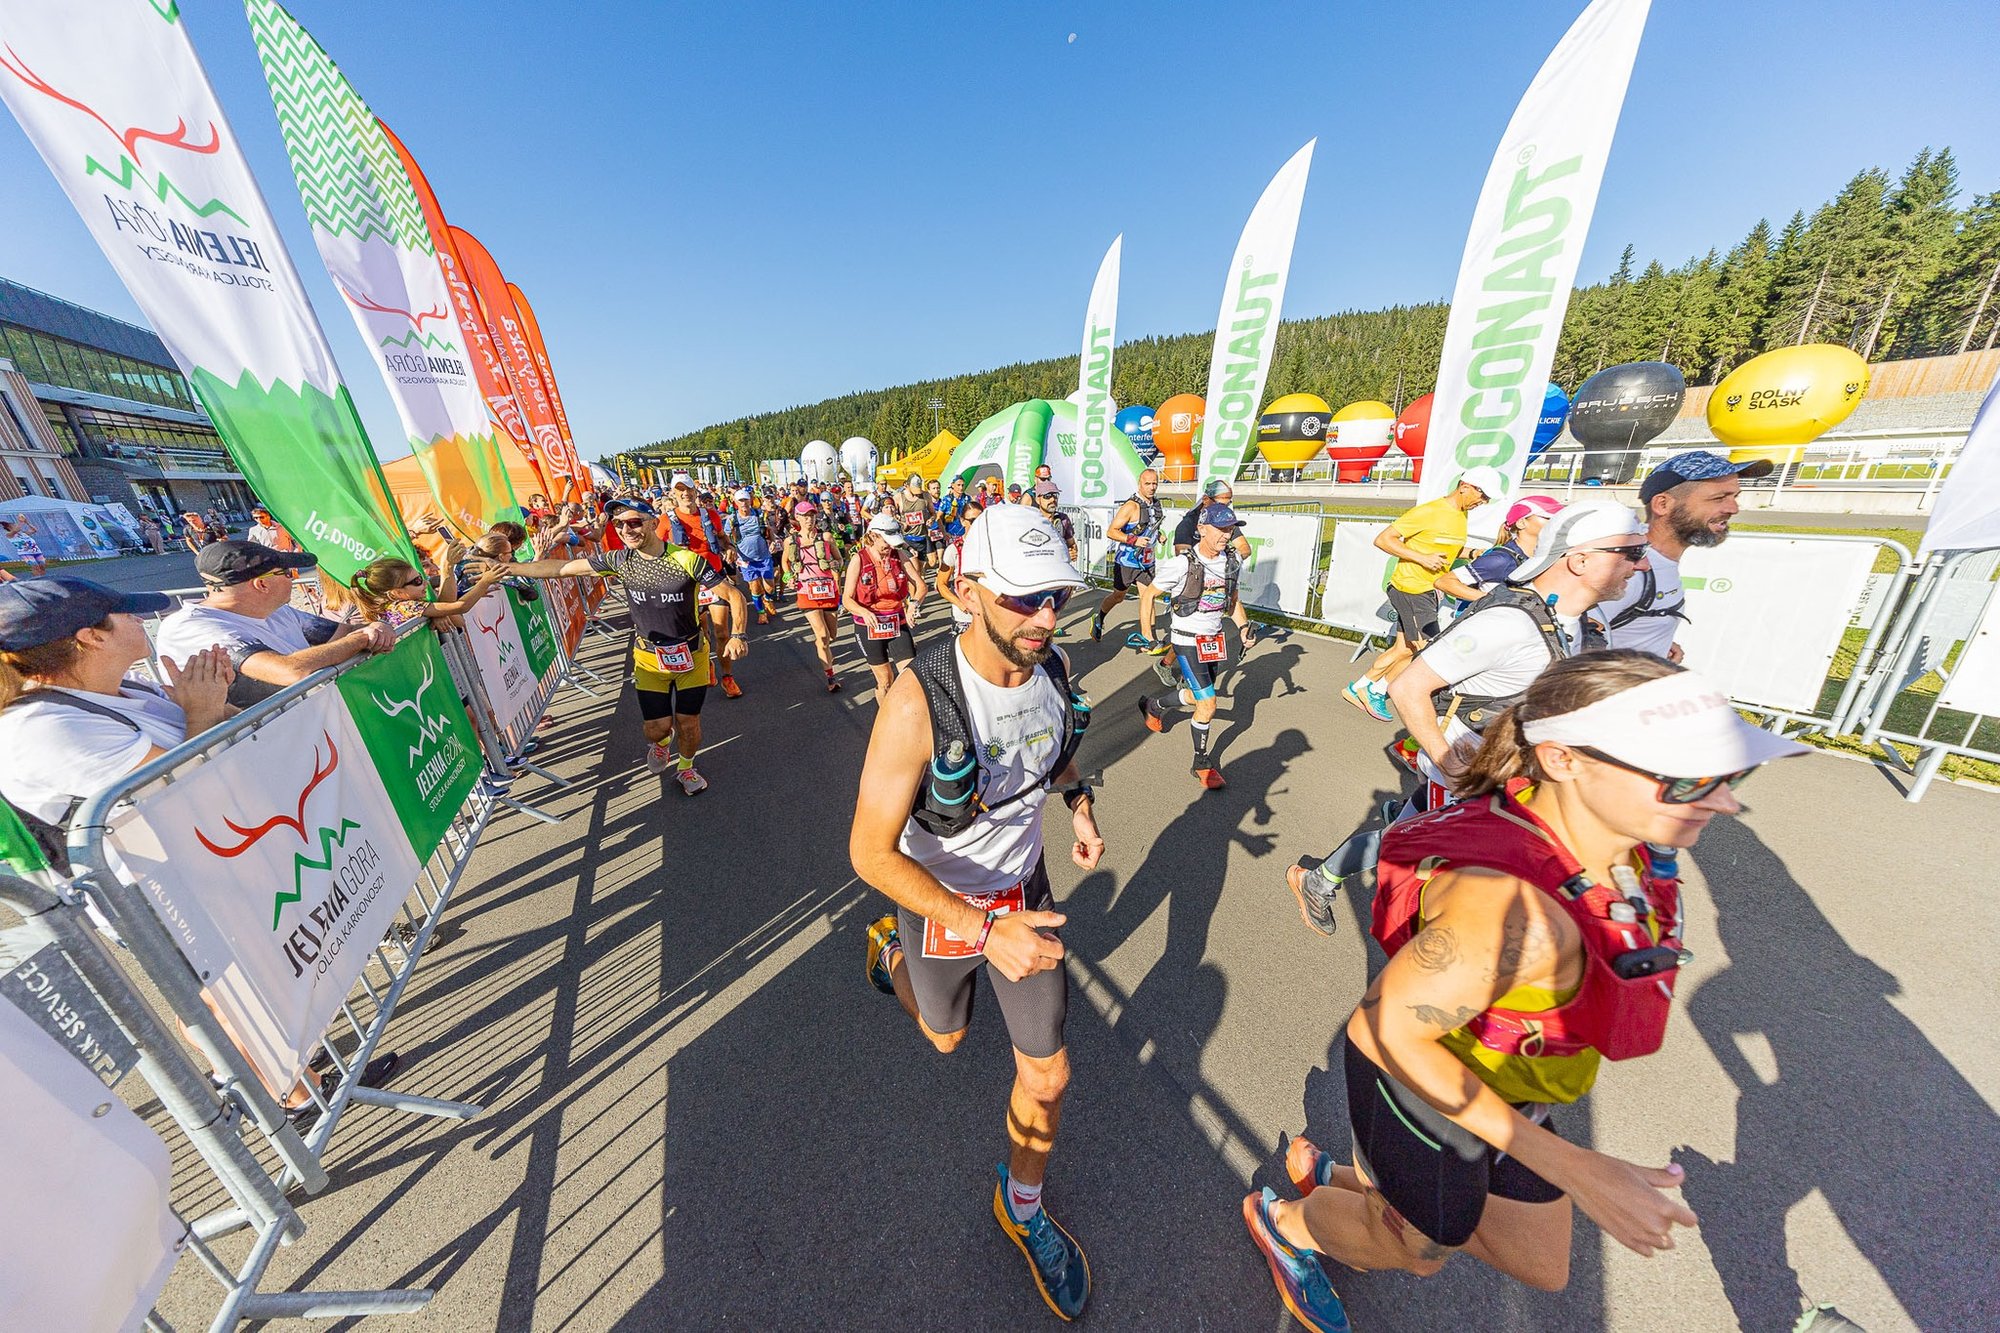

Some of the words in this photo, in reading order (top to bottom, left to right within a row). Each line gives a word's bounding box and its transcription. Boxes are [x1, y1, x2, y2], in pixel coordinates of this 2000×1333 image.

[1577, 392, 1679, 409] BRUBECK
[1750, 386, 1810, 401] DOLNY
[1080, 324, 1111, 498] COCONAUT
[1056, 432, 1077, 445] COC
[660, 592, 684, 603] DALI
[1202, 643, 1218, 651] 155
[664, 654, 684, 663] 151
[415, 751, 448, 801] JELENIA
[340, 839, 381, 896] GÓRA
[341, 872, 386, 940] KARKONOSZY
[16, 961, 86, 1039] SERVICE
